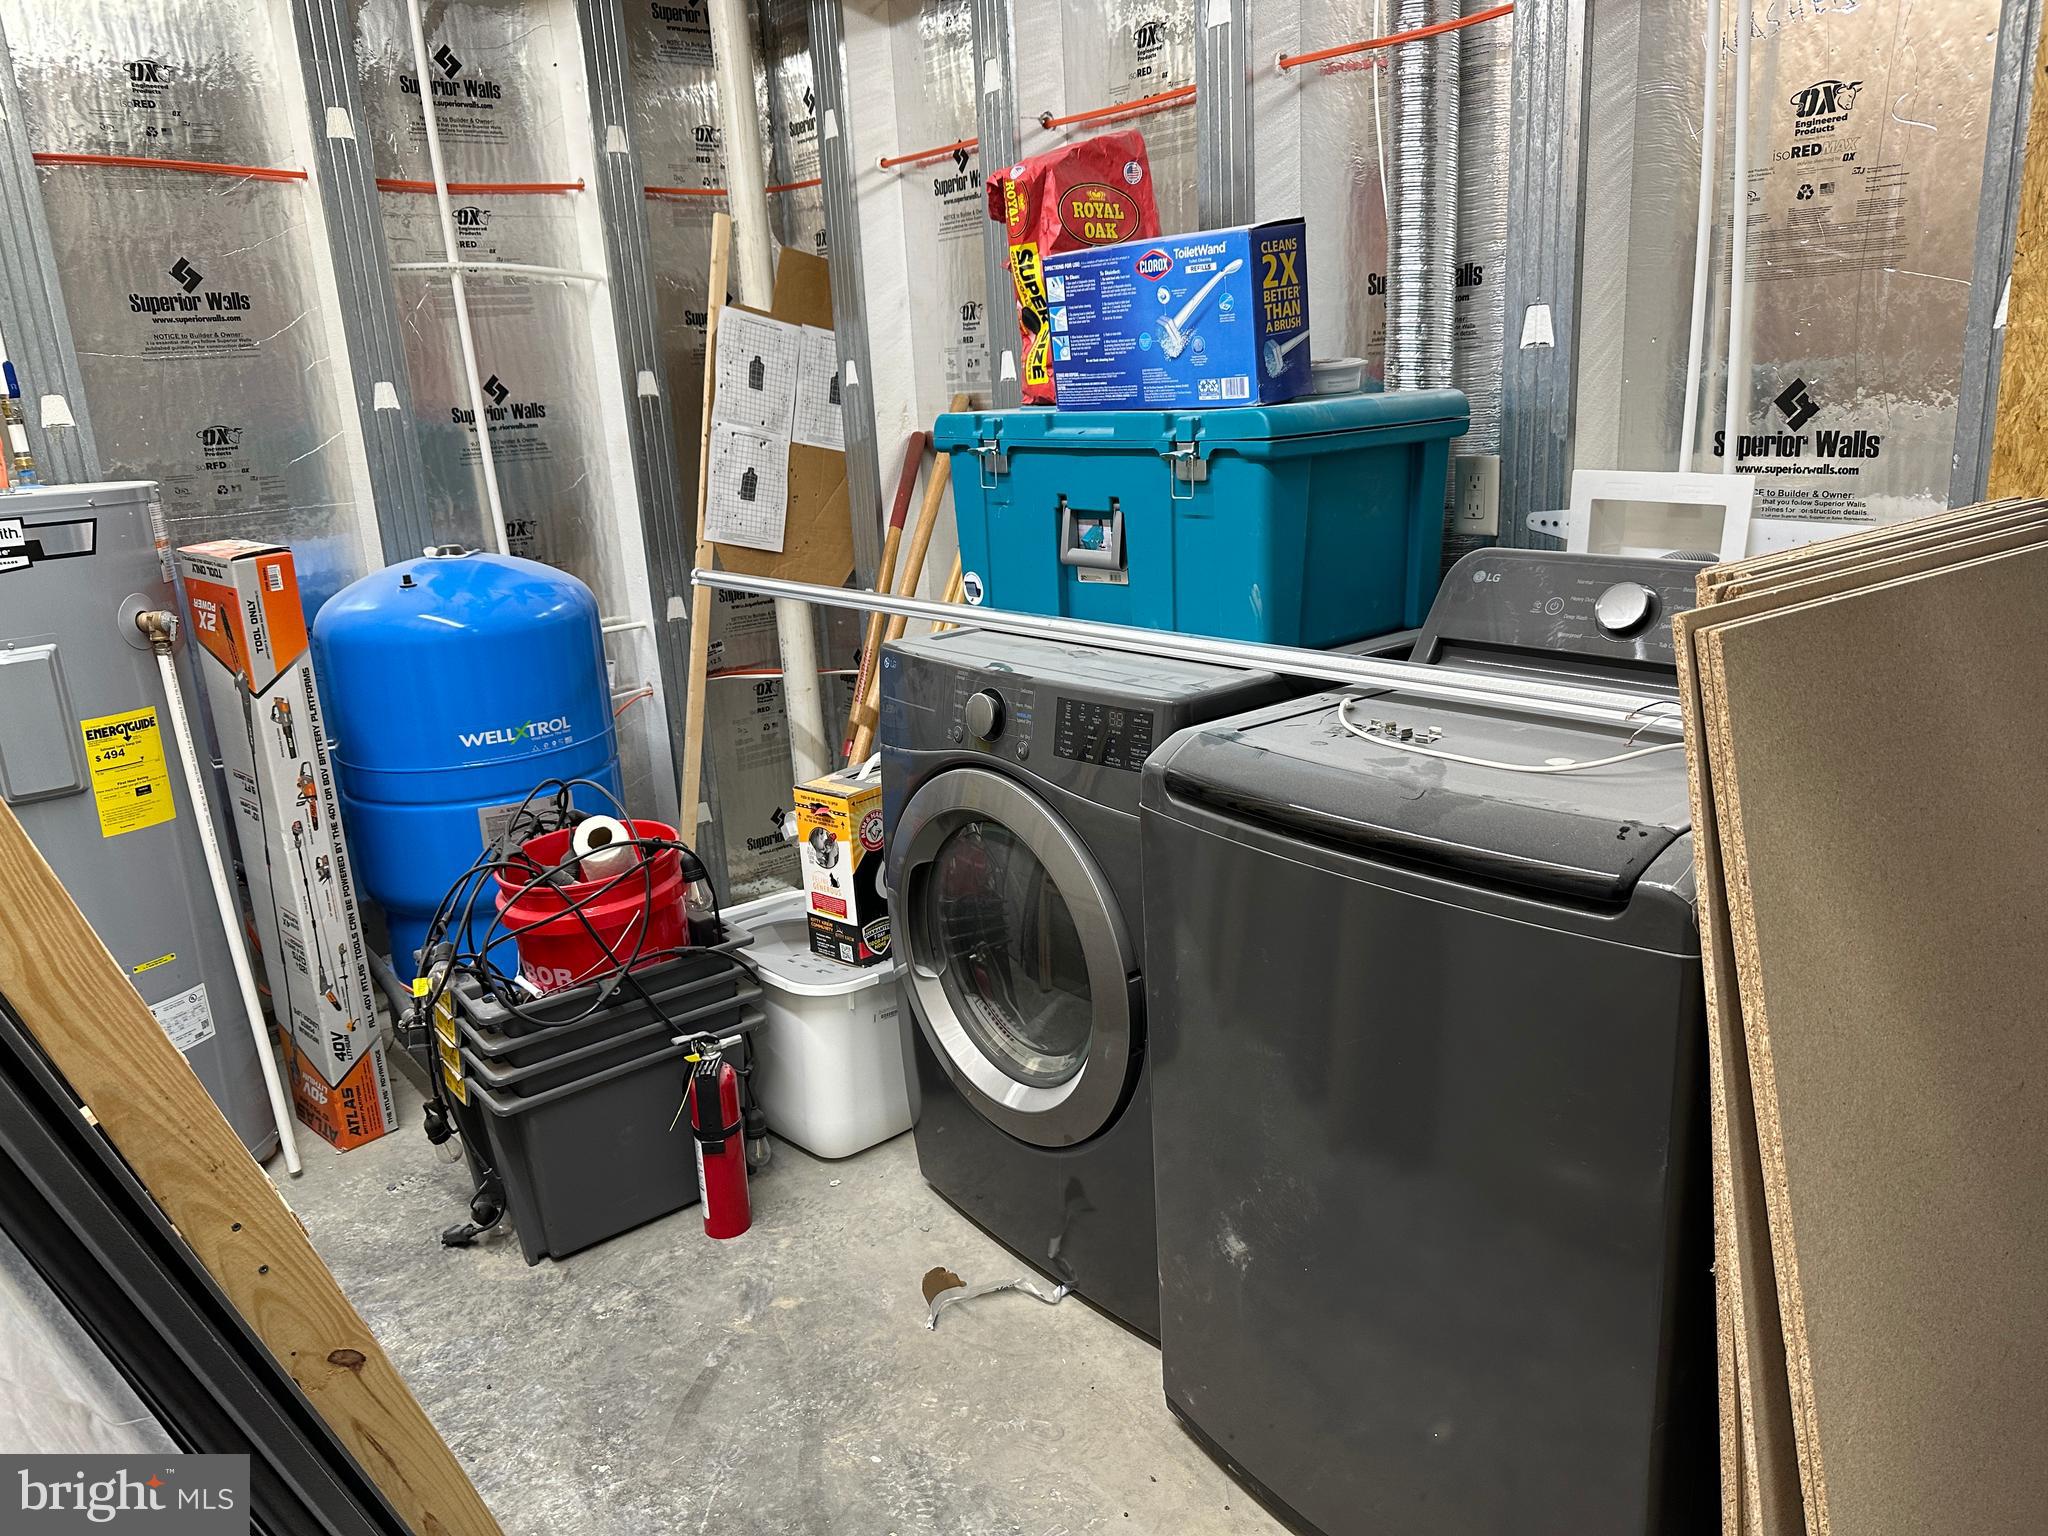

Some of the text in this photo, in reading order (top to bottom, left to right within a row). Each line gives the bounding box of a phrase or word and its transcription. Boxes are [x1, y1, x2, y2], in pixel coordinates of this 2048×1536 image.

[651, 2, 700, 23] Superior
[1136, 24, 1157, 49] OX
[1137, 44, 1162, 58] Engineered
[1137, 52, 1156, 62] Products
[130, 62, 158, 82] OX
[400, 75, 501, 99] Surior Walls
[1796, 84, 1842, 118] OX
[789, 117, 816, 137] Superior
[1795, 112, 1848, 128] Engineered
[696, 128, 713, 142] OX
[1794, 125, 1834, 136] Products
[1842, 152, 1857, 162] OX
[934, 174, 968, 197] Superior
[1005, 181, 1020, 226] ROYAL
[1072, 201, 1125, 220] ROYAL
[458, 210, 480, 225] OX
[1084, 222, 1119, 239] OAK
[1174, 242, 1226, 259] ToiletWand
[1261, 238, 1297, 253] CLEANS
[1140, 258, 1168, 273] CLOROX
[1262, 251, 1298, 288] 2X
[1455, 263, 1482, 288] alls
[1264, 286, 1300, 303] BETTER
[129, 292, 250, 315] Superior Walls
[962, 303, 976, 321] OX
[1264, 300, 1300, 320] THAN
[152, 314, 241, 324] www.superiorwalls.com
[1266, 316, 1301, 333] A BRUSH
[451, 403, 546, 425] Suprior Walls
[202, 429, 229, 446] OX
[1713, 430, 1880, 461] Sperior Walls
[1736, 464, 1859, 476] www.superiorwalls.com
[1822, 490, 1854, 499] Owner:
[0, 528, 21, 539] ith.
[192, 563, 206, 575] ONLY
[207, 566, 222, 579] TOOL
[1486, 573, 1501, 582] LG
[193, 598, 216, 612] POWER
[199, 610, 216, 631] 2X
[247, 600, 264, 654] TOOL ONLY
[302, 667, 319, 722] PLATFORMS
[756, 682, 772, 696] OX
[86, 716, 156, 741] ENERGYGUIDE
[312, 725, 327, 765] BATTERY
[104, 749, 126, 760] 494
[319, 769, 330, 785] 80V
[323, 788, 332, 800] OR
[326, 803, 337, 820] 40V
[870, 812, 882, 820] HAM
[329, 822, 339, 840] THE
[334, 842, 342, 853] BY
[747, 831, 785, 850] Superio
[337, 855, 350, 897] POWERED
[345, 898, 353, 911] BE
[347, 912, 357, 930] CAN
[351, 932, 363, 960] TOOLS
[363, 994, 372, 1010] 40V
[367, 1012, 376, 1028] ALL
[330, 1031, 347, 1062] 40V
[343, 1034, 353, 1060] LITHIUM
[375, 1050, 386, 1087] ADVANTAGE
[302, 1072, 327, 1092] LITHIUM
[303, 1083, 327, 1104] 40V
[341, 1088, 361, 1137] ATLAS
[385, 1112, 394, 1124] THE
